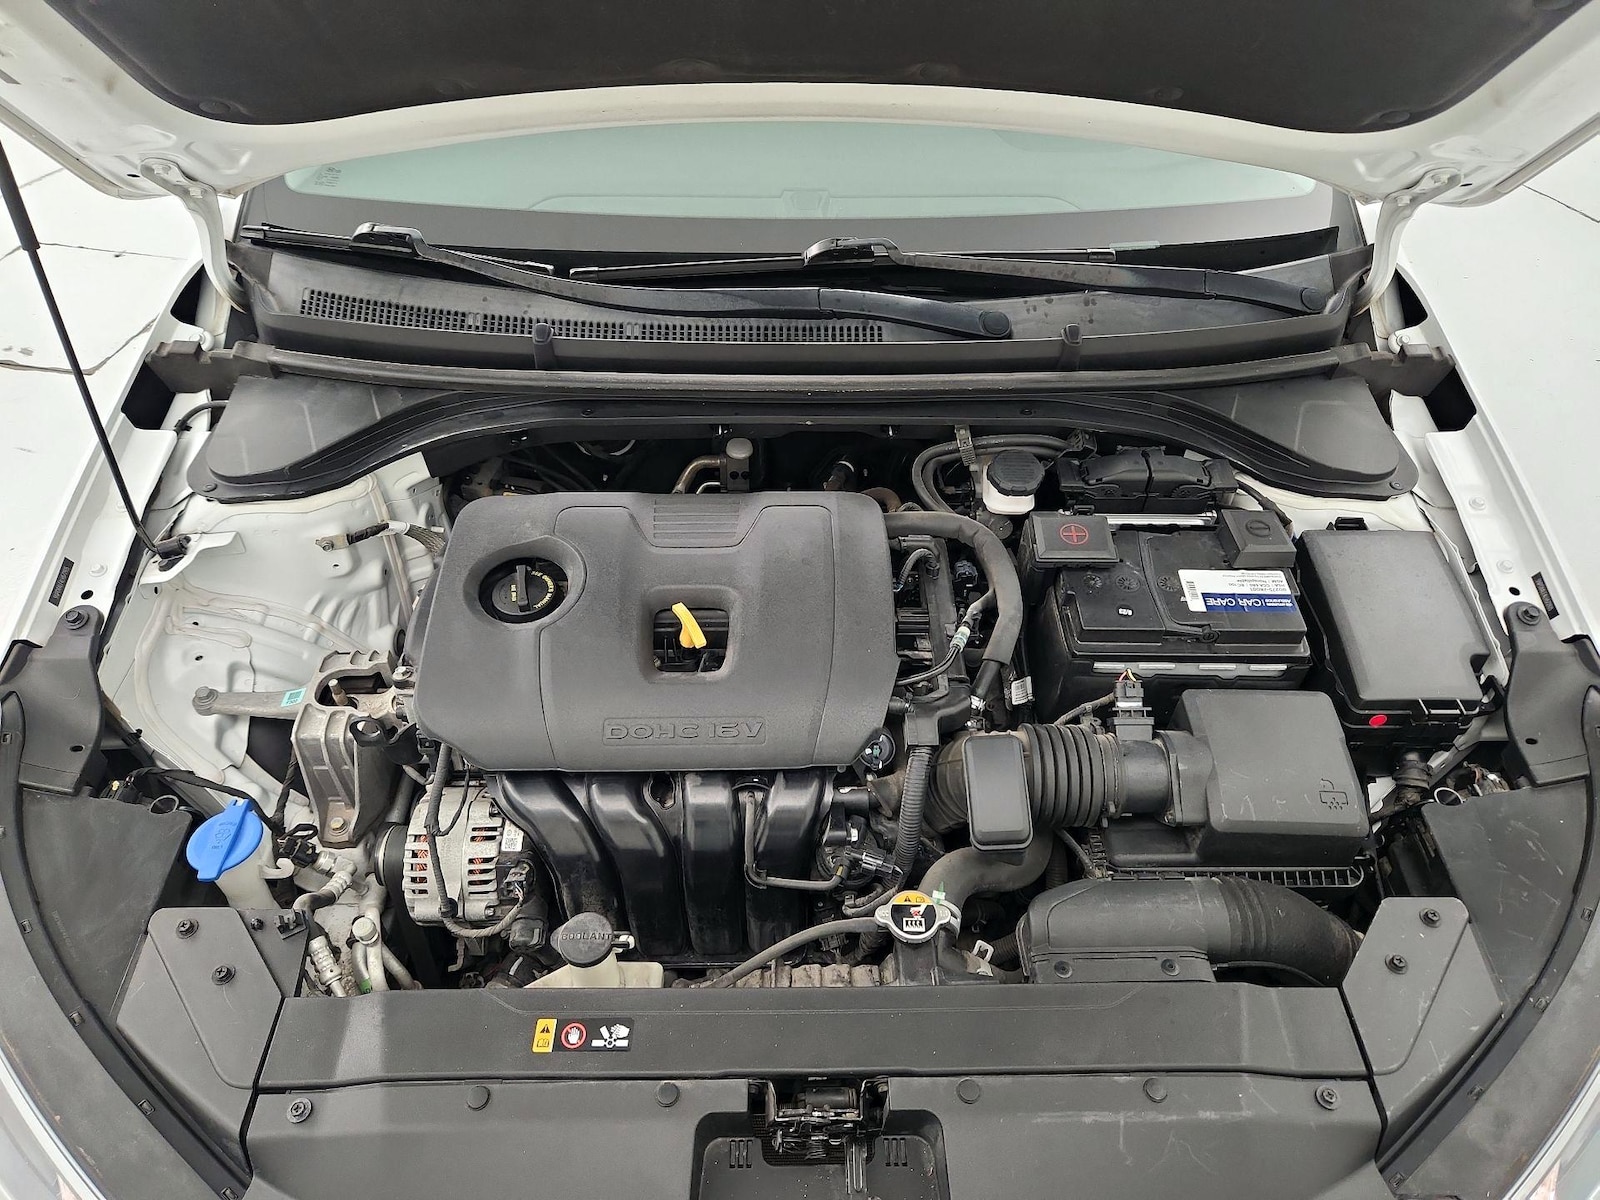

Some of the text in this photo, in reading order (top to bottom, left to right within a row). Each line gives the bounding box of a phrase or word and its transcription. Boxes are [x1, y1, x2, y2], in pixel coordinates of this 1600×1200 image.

[1205, 597, 1236, 606] CARE
[1238, 598, 1261, 607] CAR
[605, 722, 763, 740] DOHC 16V
[561, 932, 612, 941] COOLANT
